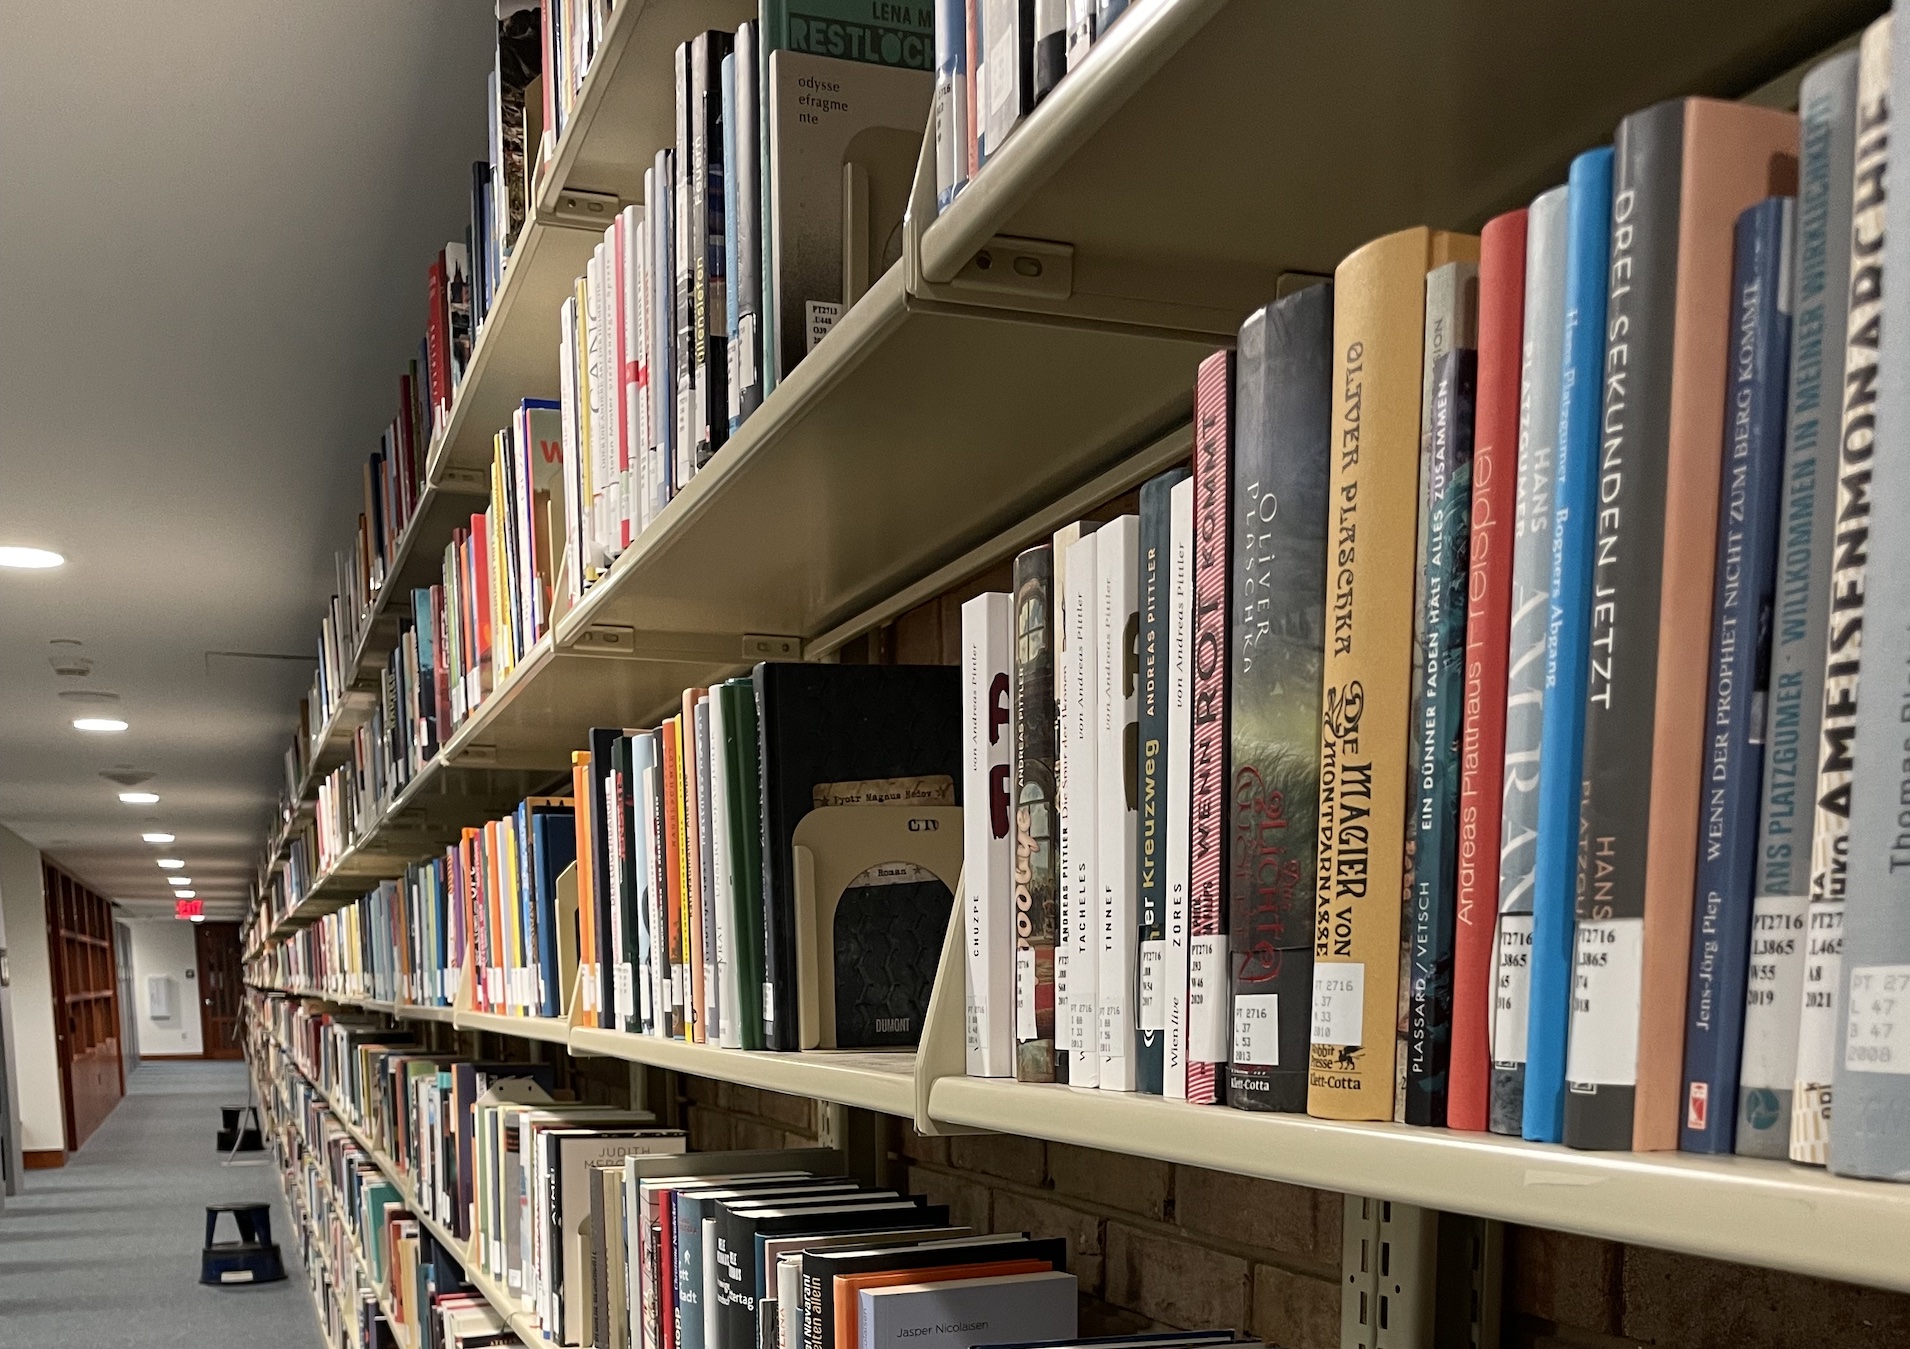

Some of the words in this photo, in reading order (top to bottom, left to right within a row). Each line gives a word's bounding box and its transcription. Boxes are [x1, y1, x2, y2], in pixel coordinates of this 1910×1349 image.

[872, 1, 912, 26] LENA
[798, 76, 840, 93] odysse
[798, 94, 849, 113] efragme
[799, 112, 819, 125] nte
[1611, 190, 1635, 299] DREI
[1738, 282, 1760, 382] KOMMT
[1340, 341, 1365, 474] OLIVER
[1434, 380, 1448, 502] ZUSAMMEN
[1597, 315, 1629, 567] SEKUNDEN
[1733, 388, 1752, 459] BERG
[1792, 418, 1819, 452] IN
[1202, 413, 1217, 569] KOMMT
[1531, 447, 1551, 534] HANS
[1729, 465, 1747, 526] ZUM
[1177, 541, 1185, 597] Pittler
[1333, 484, 1358, 658] PLASCHKA
[1431, 508, 1444, 566] ALLES
[1466, 445, 1497, 650] Freispiel
[1552, 506, 1569, 599] Bogners
[1724, 530, 1743, 609] NICHT
[1780, 457, 1817, 646] WILLKOMMEN
[1147, 547, 1156, 622] PITTLER
[1243, 481, 1260, 673] PLASCHKA
[1429, 575, 1441, 625] HÄLT
[1076, 591, 1084, 640] Pittler
[1175, 602, 1185, 672] Andreas
[1545, 603, 1563, 688] Abgang
[1590, 585, 1616, 710] JETZT
[1147, 630, 1156, 717] ANDREAS
[1197, 588, 1219, 725] ROT
[1427, 632, 1439, 699] FADEN
[1716, 614, 1738, 725] PROPHET
[1018, 724, 1026, 787] ANDREAS
[1421, 705, 1436, 789] DÜNNER
[1462, 661, 1482, 797] Platthaus
[1713, 732, 1730, 781] DER
[1768, 670, 1802, 837] PLATZGUMER
[865, 791, 901, 803] Magnus
[1143, 738, 1160, 888] Kreuzweg
[1197, 738, 1212, 860] WENN
[1315, 686, 1347, 957] MONTPARNASSE
[1336, 760, 1373, 901] MAGIER
[1421, 796, 1433, 831] EIN
[1707, 788, 1725, 861] WENN
[877, 868, 907, 877] Roman
[1458, 812, 1477, 926] Andreas
[1592, 836, 1617, 921] HANS
[1764, 844, 1792, 894] ANS
[1172, 883, 1183, 948] ZORES
[1334, 905, 1353, 958] VON
[1417, 882, 1430, 957] VETSCH
[1703, 891, 1722, 934] Plep
[1143, 952, 1162, 962] PT2716
[1191, 944, 1213, 955] PT2716
[1171, 996, 1180, 1026] live
[1246, 1008, 1267, 1019] 2716
[1326, 980, 1354, 991] 2716
[1696, 940, 1719, 1031] Jens-Jörg
[875, 1017, 911, 1033] DUMONT
[1170, 1029, 1179, 1068] Wien
[1235, 1051, 1251, 1062] 2013
[1242, 1023, 1251, 1033] 37
[1412, 977, 1426, 1073] PLASSARD
[598, 1146, 650, 1158] JUDITH
[811, 1276, 822, 1315] allein
[896, 1324, 934, 1339] Jasper
[935, 1319, 989, 1336] Nicolaisen
